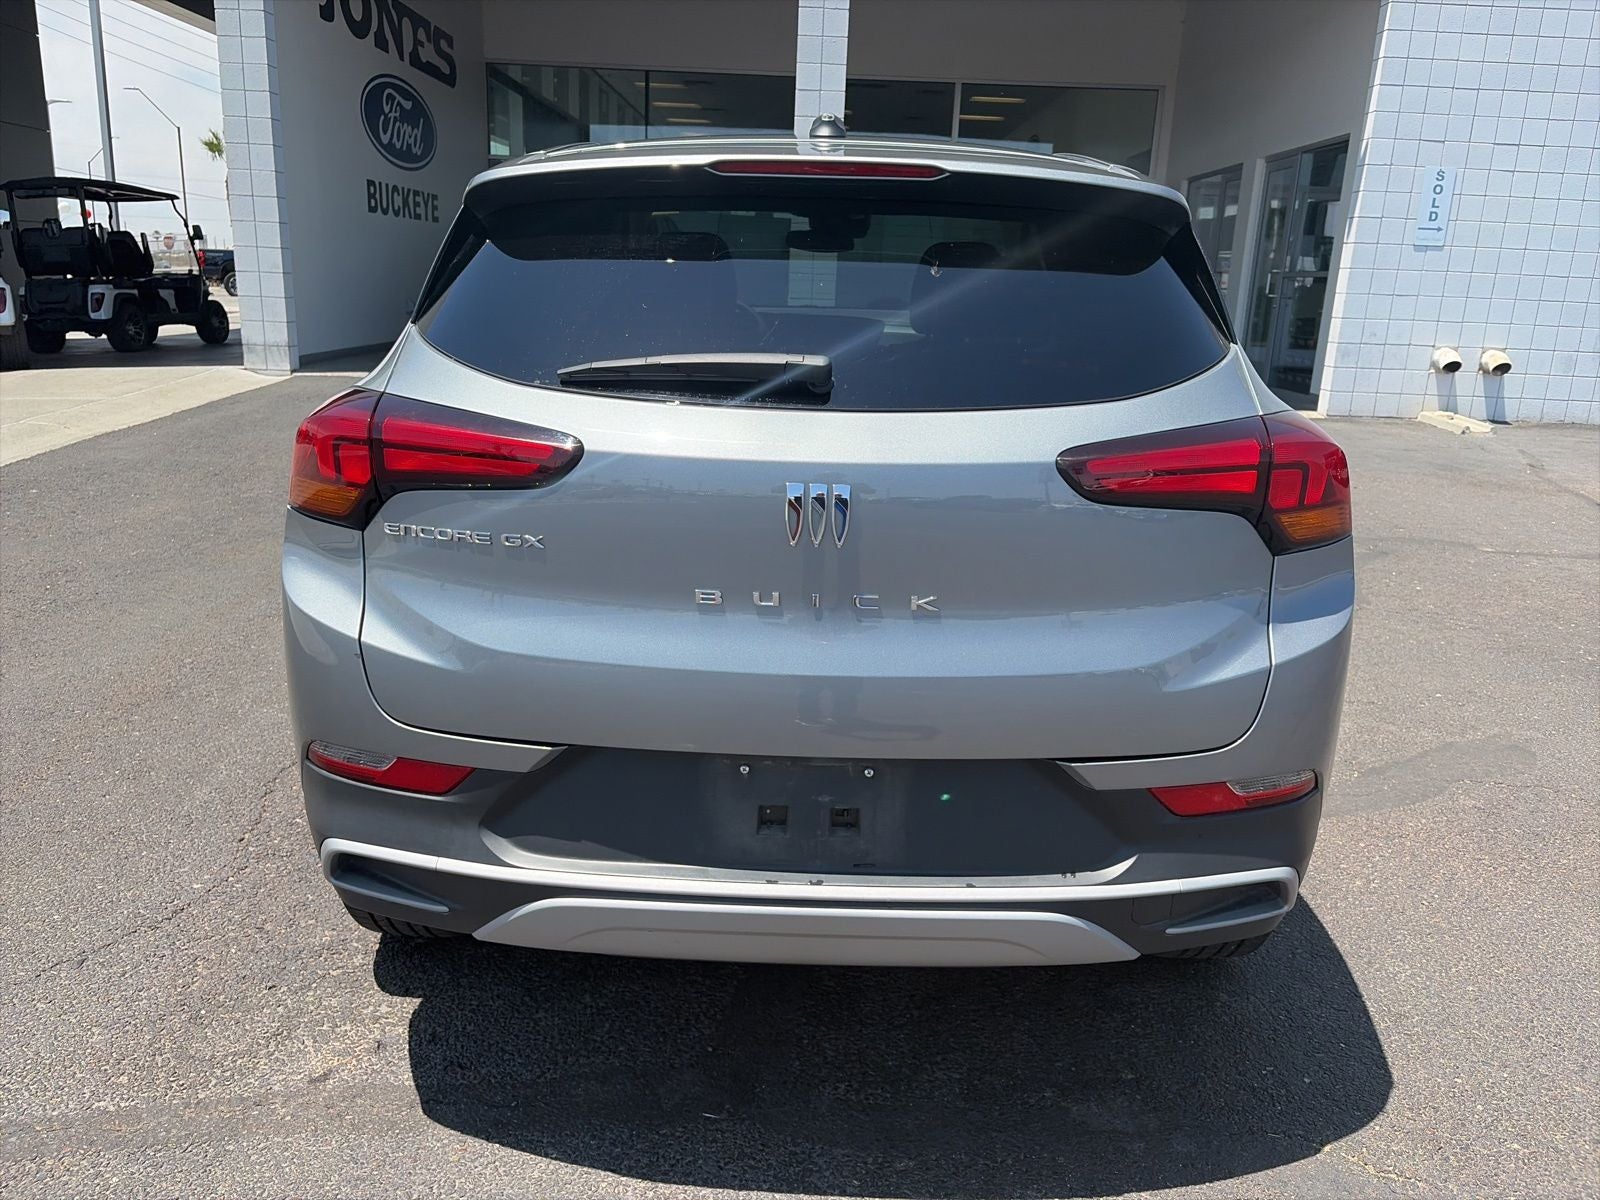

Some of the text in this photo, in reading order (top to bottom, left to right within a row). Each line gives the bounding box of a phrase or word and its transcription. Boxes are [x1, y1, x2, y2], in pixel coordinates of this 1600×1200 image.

[379, 88, 424, 156] Ford
[366, 178, 440, 223] BUCKEYE
[1428, 169, 1446, 222] SOLD
[383, 522, 545, 549] ENCORE GX
[695, 589, 940, 611] BUICK
